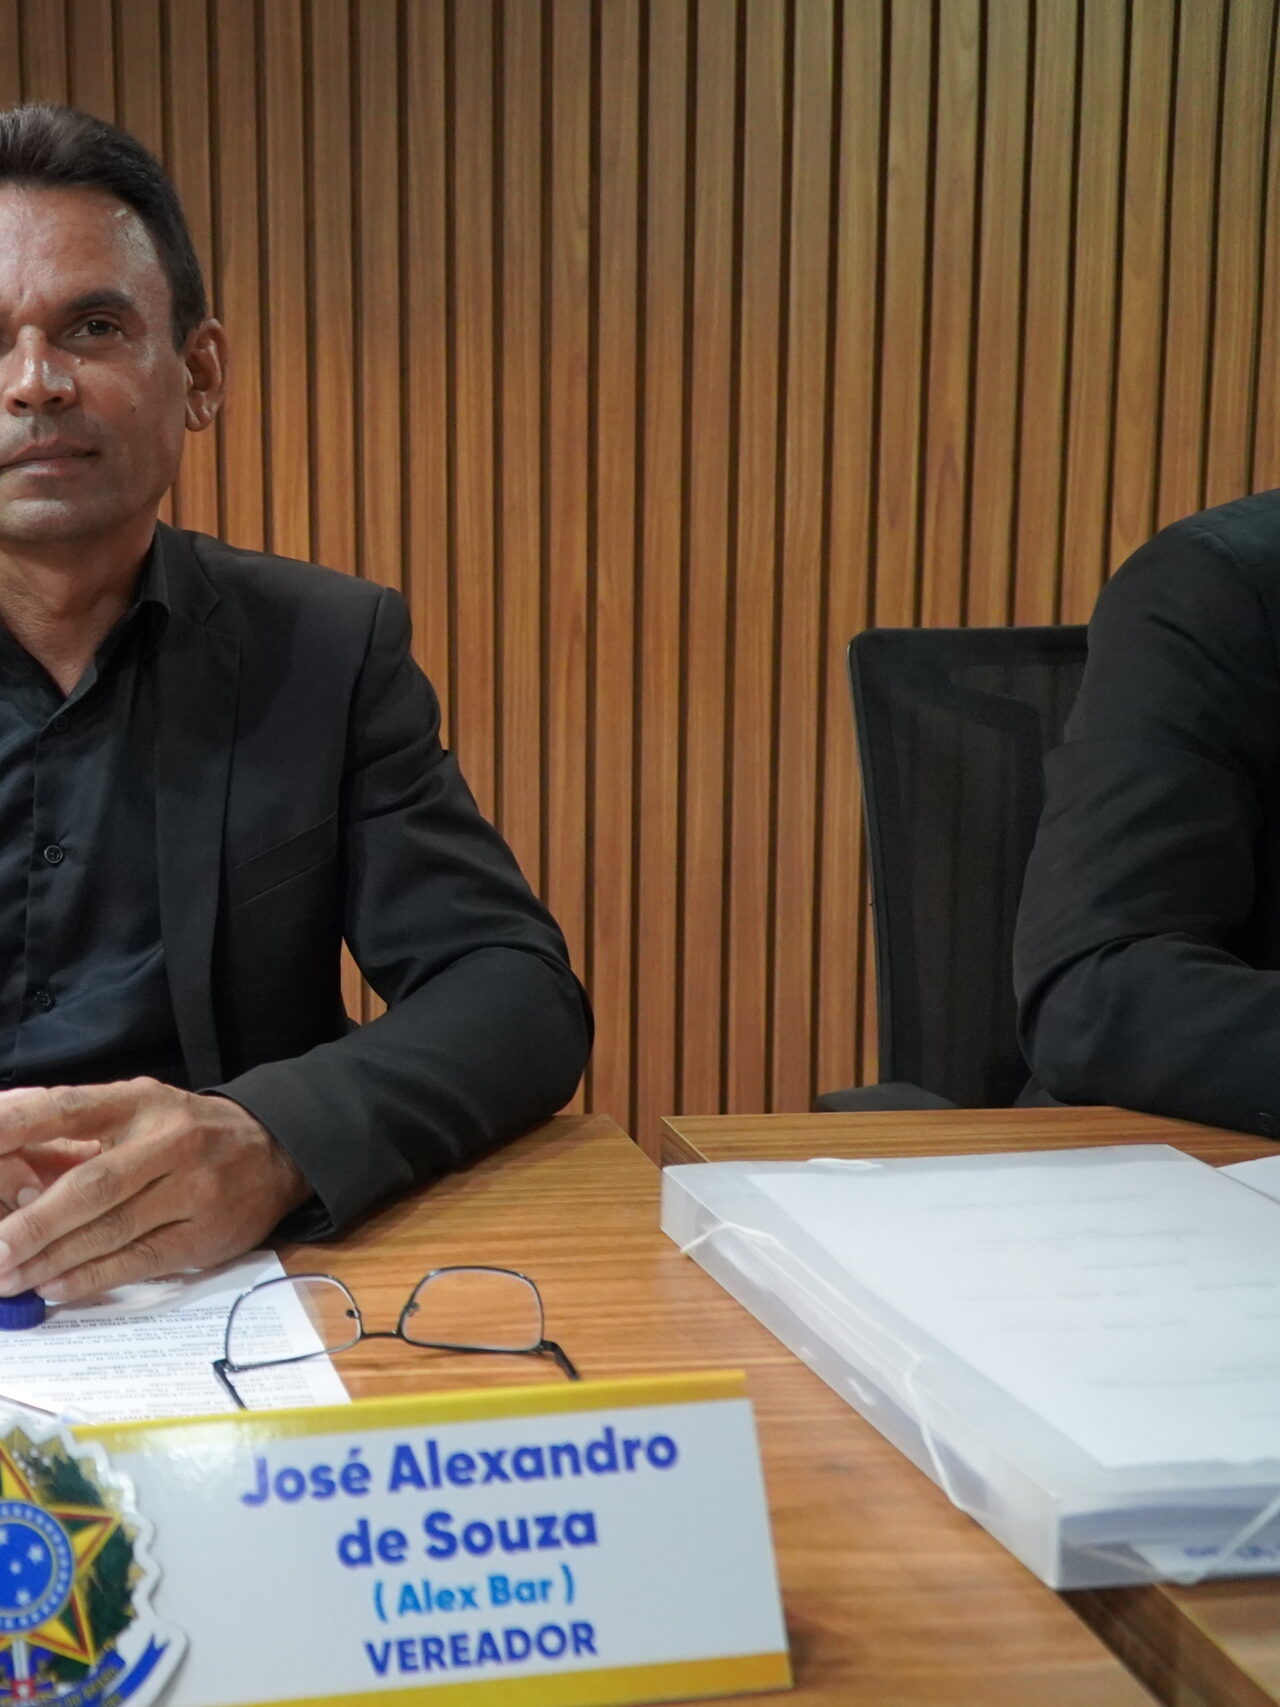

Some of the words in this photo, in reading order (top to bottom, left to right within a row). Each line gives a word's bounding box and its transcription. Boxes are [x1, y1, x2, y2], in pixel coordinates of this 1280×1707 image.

[242, 1448, 371, 1505] José
[389, 1427, 677, 1492] Alexandro
[338, 1518, 408, 1567] de
[423, 1510, 597, 1559] Souza
[365, 1621, 595, 1675] VEREADOR
